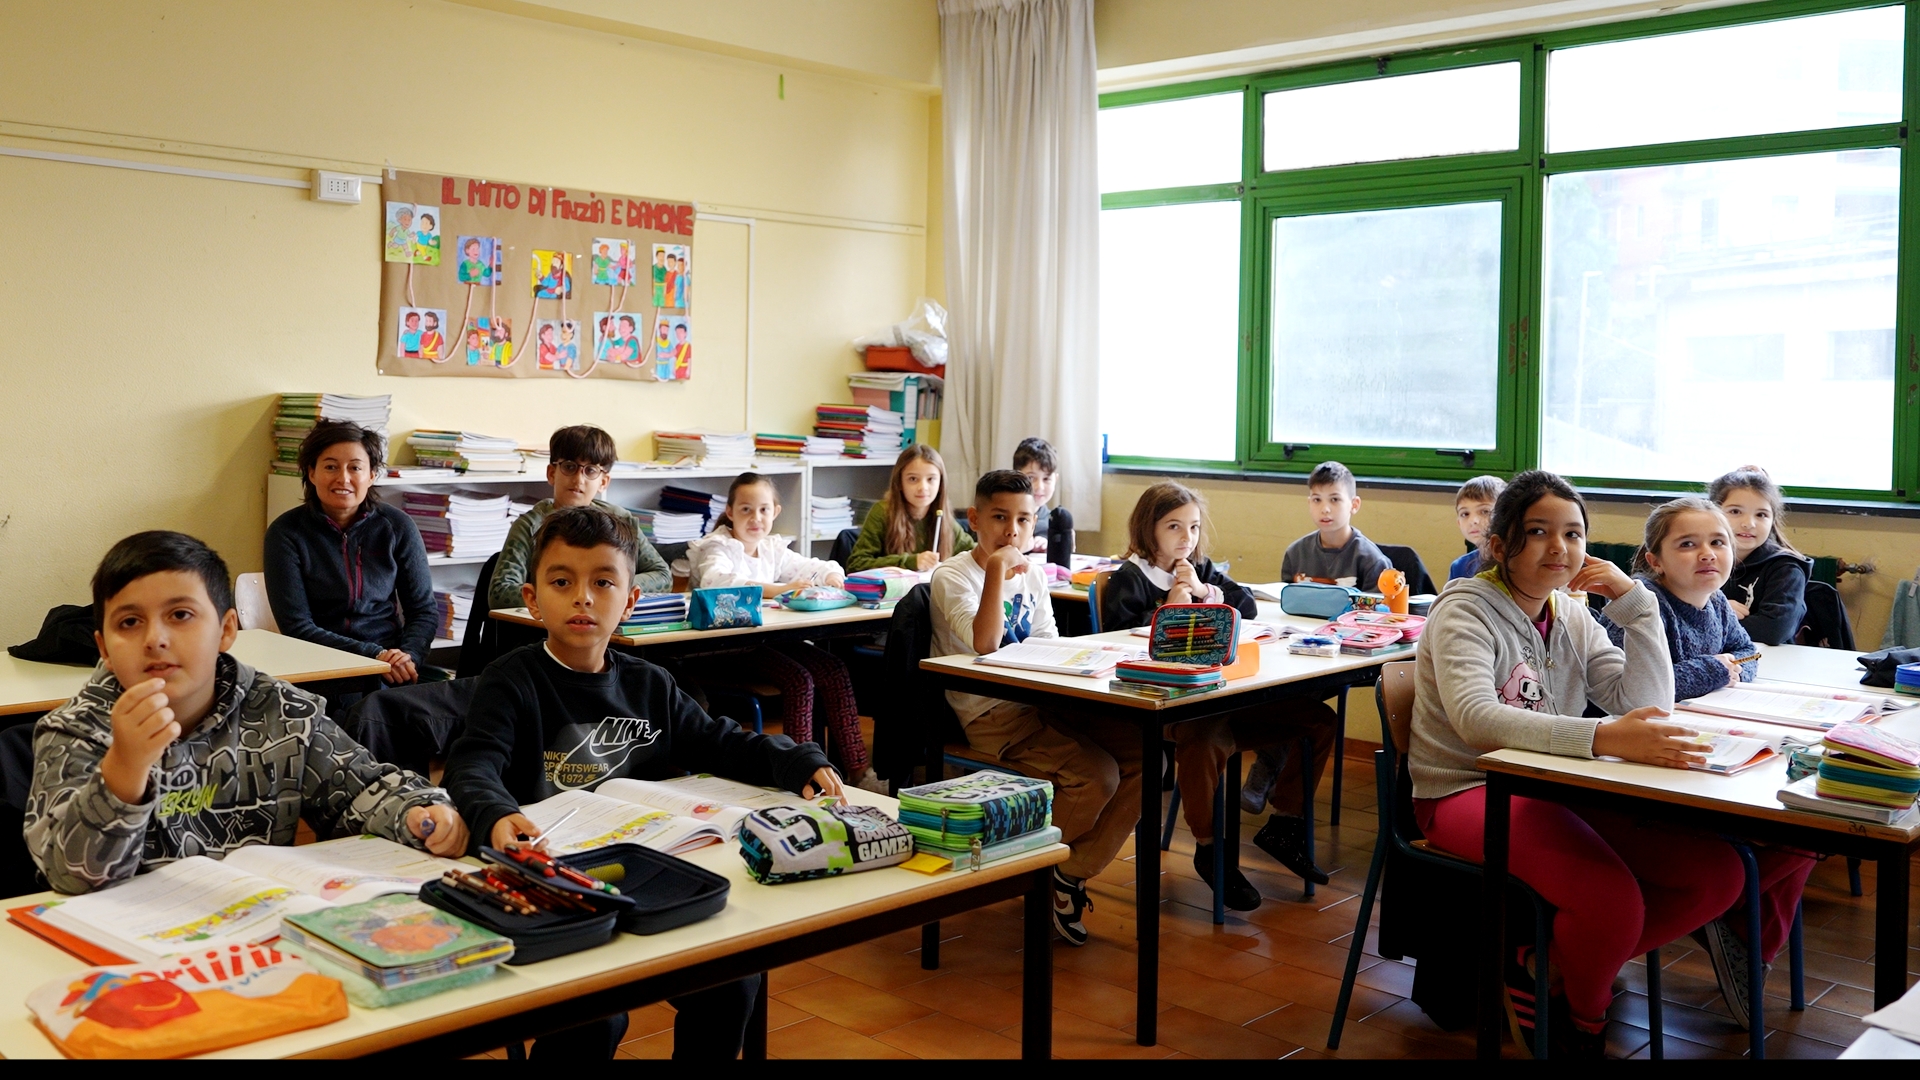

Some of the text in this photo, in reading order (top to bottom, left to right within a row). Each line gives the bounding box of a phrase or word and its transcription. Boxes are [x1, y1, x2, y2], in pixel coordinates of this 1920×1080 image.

[441, 177, 462, 205] IL
[467, 179, 521, 210] MITO
[528, 187, 547, 217] DI
[611, 199, 623, 225] E
[626, 199, 694, 236] DAMONE
[591, 716, 651, 746] NIKE
[543, 751, 568, 761] NIKE
[543, 761, 609, 773] SPORTSWEAR
[561, 773, 584, 783] 1972
